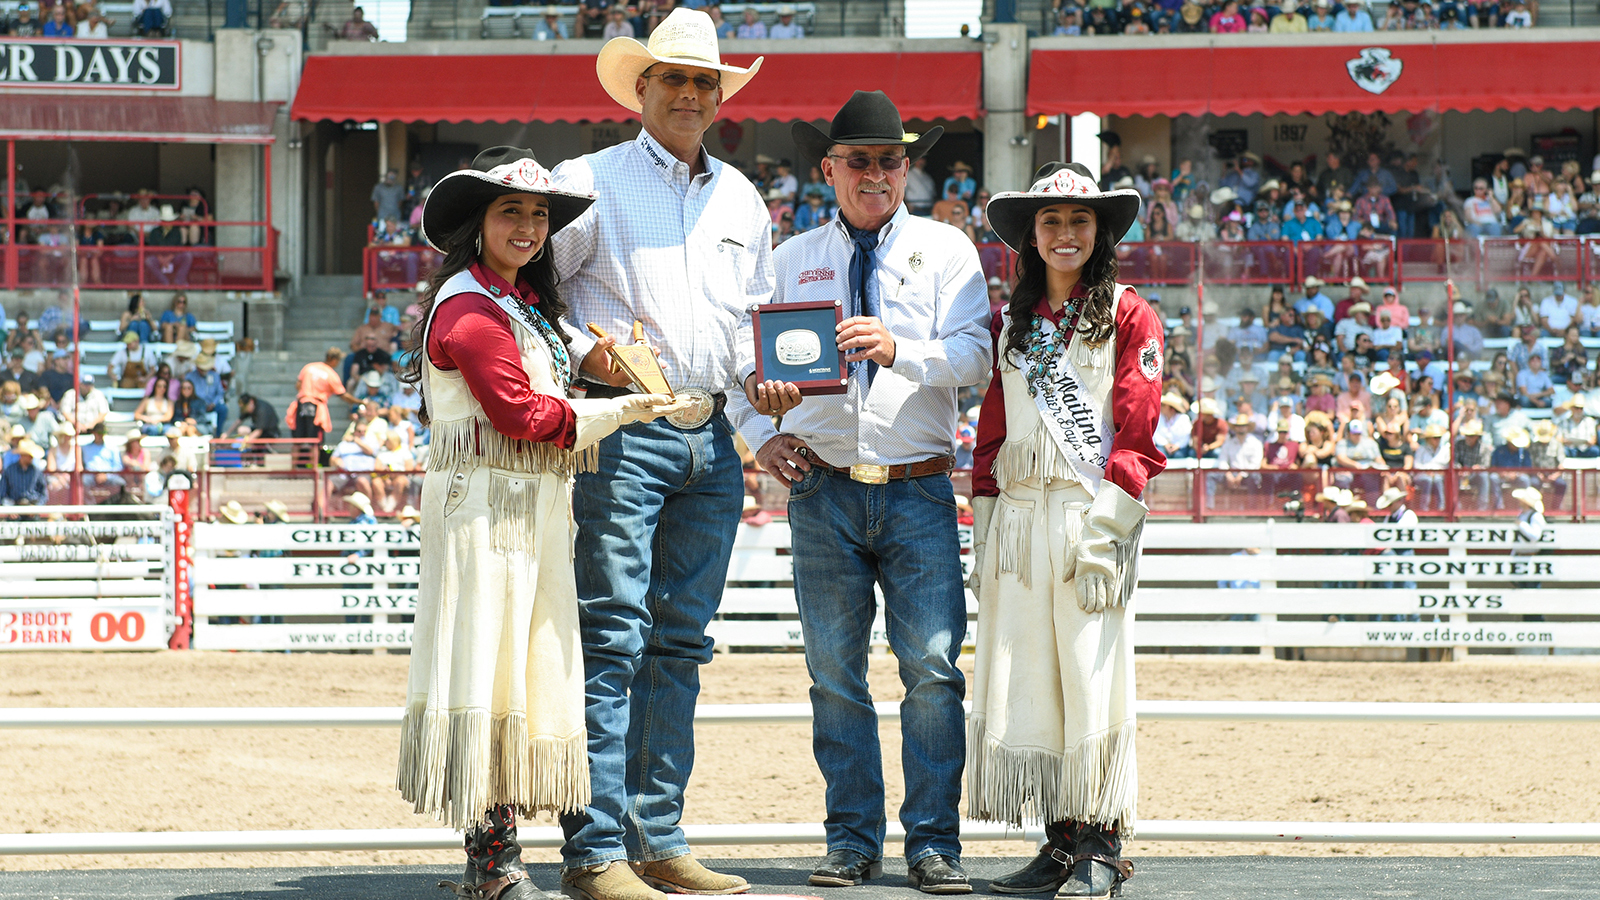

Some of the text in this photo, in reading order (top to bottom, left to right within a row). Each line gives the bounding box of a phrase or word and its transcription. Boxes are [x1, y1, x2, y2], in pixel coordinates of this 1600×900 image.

[55, 46, 160, 84] DAYS
[1273, 124, 1308, 141] 1897
[645, 144, 669, 170] Wrangler
[56, 526, 117, 537] FRONTIER
[1373, 529, 1555, 542] CHEYENNE
[1373, 562, 1553, 575] FRONTIER
[1419, 595, 1503, 608] DAYS
[22, 612, 72, 626] BOOT
[22, 630, 72, 643] BARN
[1366, 628, 1553, 641] www.cfdrodeo.com
